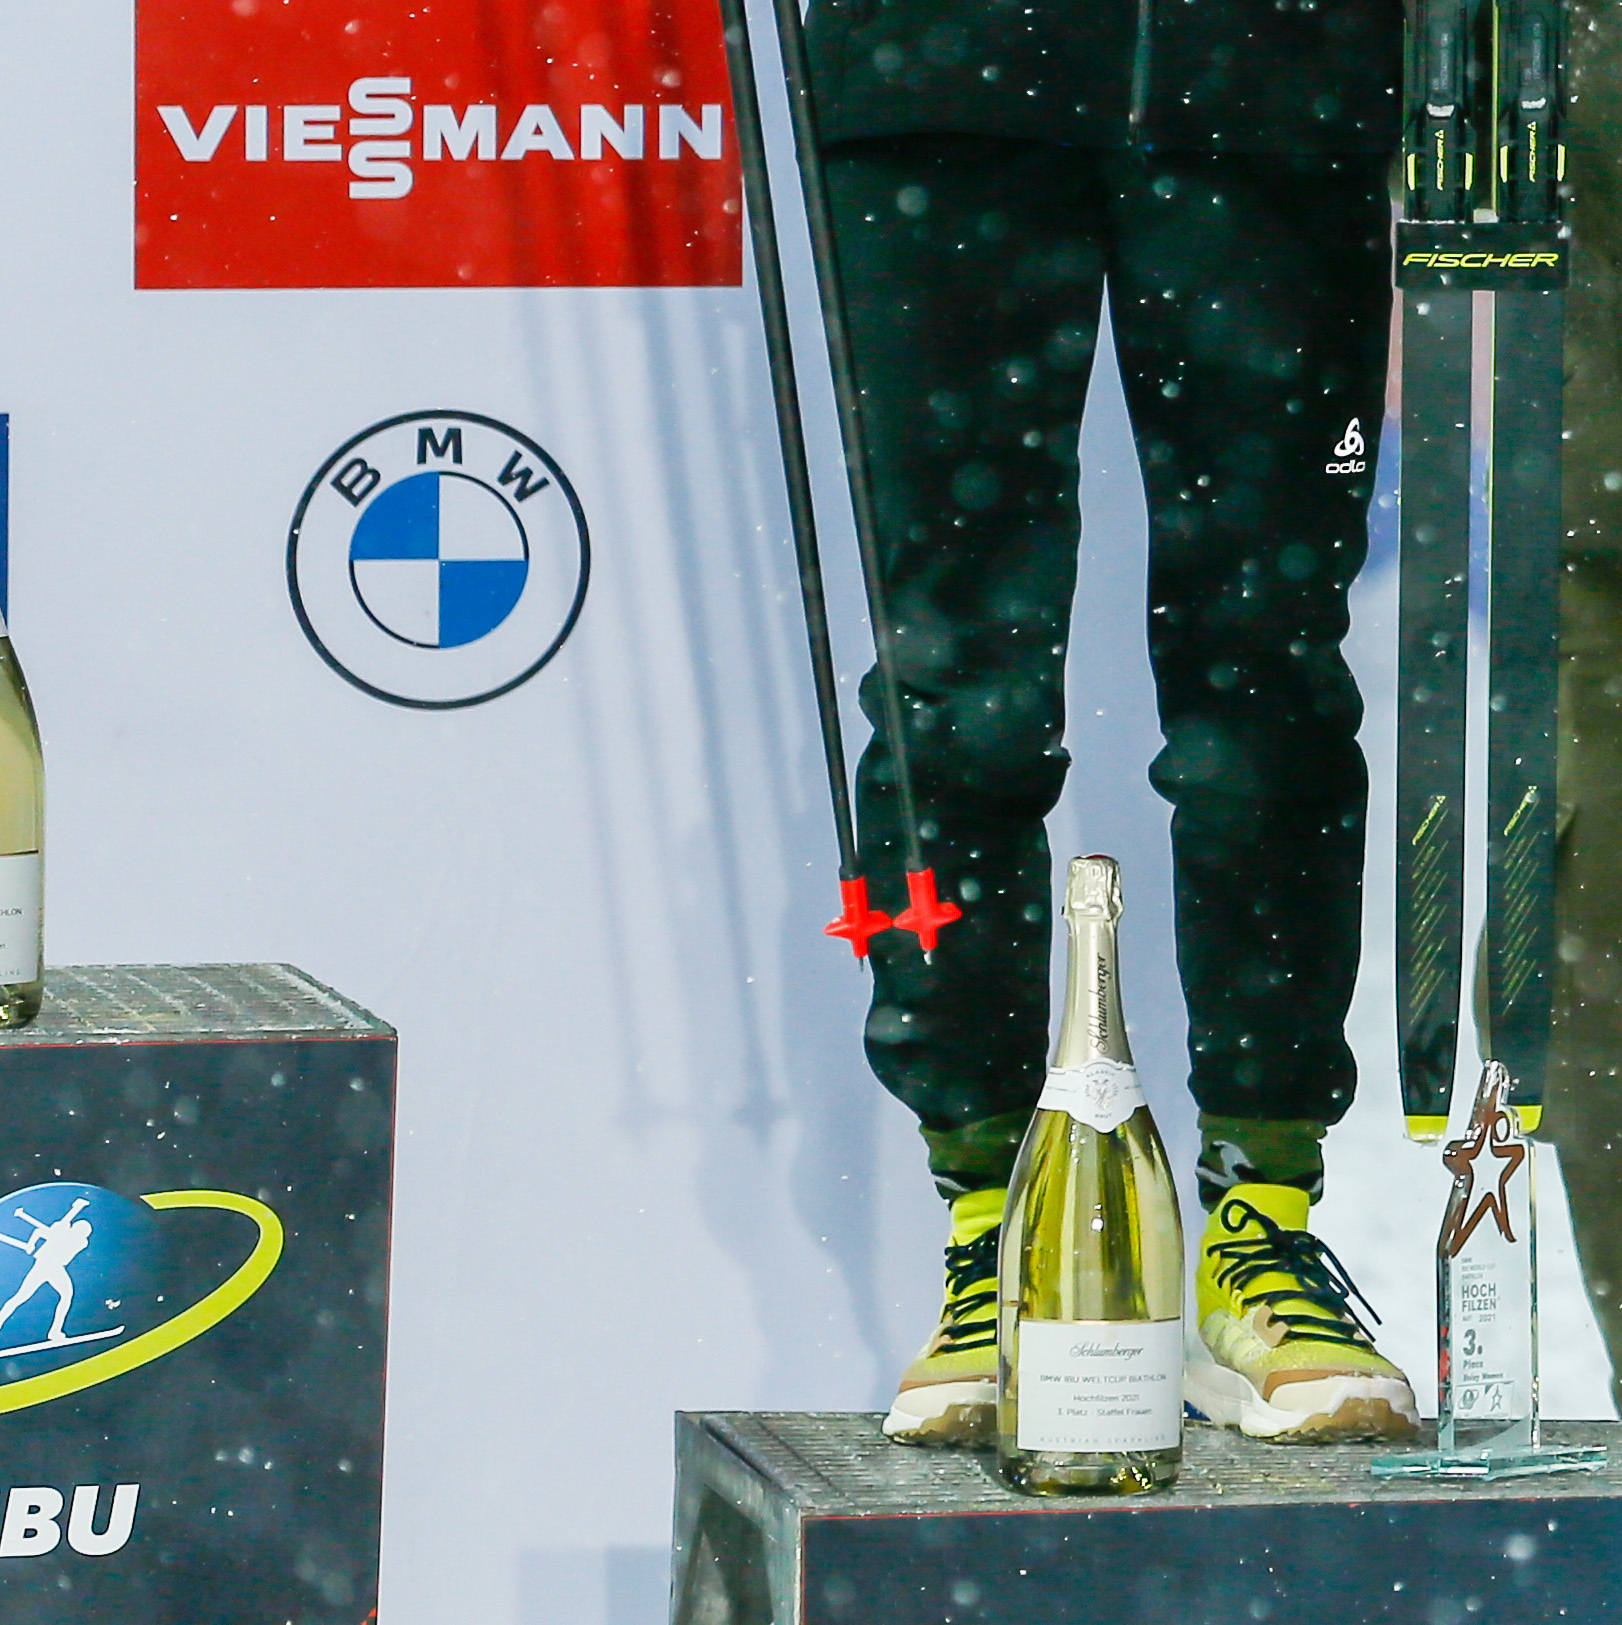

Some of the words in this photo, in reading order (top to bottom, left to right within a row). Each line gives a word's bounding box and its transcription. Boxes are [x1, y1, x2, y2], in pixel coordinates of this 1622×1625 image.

[156, 77, 722, 200] VIESSMANN
[1402, 253, 1559, 267] FISCHER
[330, 428, 549, 507] BMW
[1325, 459, 1366, 474] odlo
[1087, 953, 1112, 1054] Schlumberger
[1462, 1283, 1496, 1298] HOCH
[1462, 1299, 1496, 1312] FILZEN
[1070, 1341, 1144, 1361] Schlumberger
[1463, 1329, 1483, 1356] 3.
[0, 1482, 140, 1557] BU
